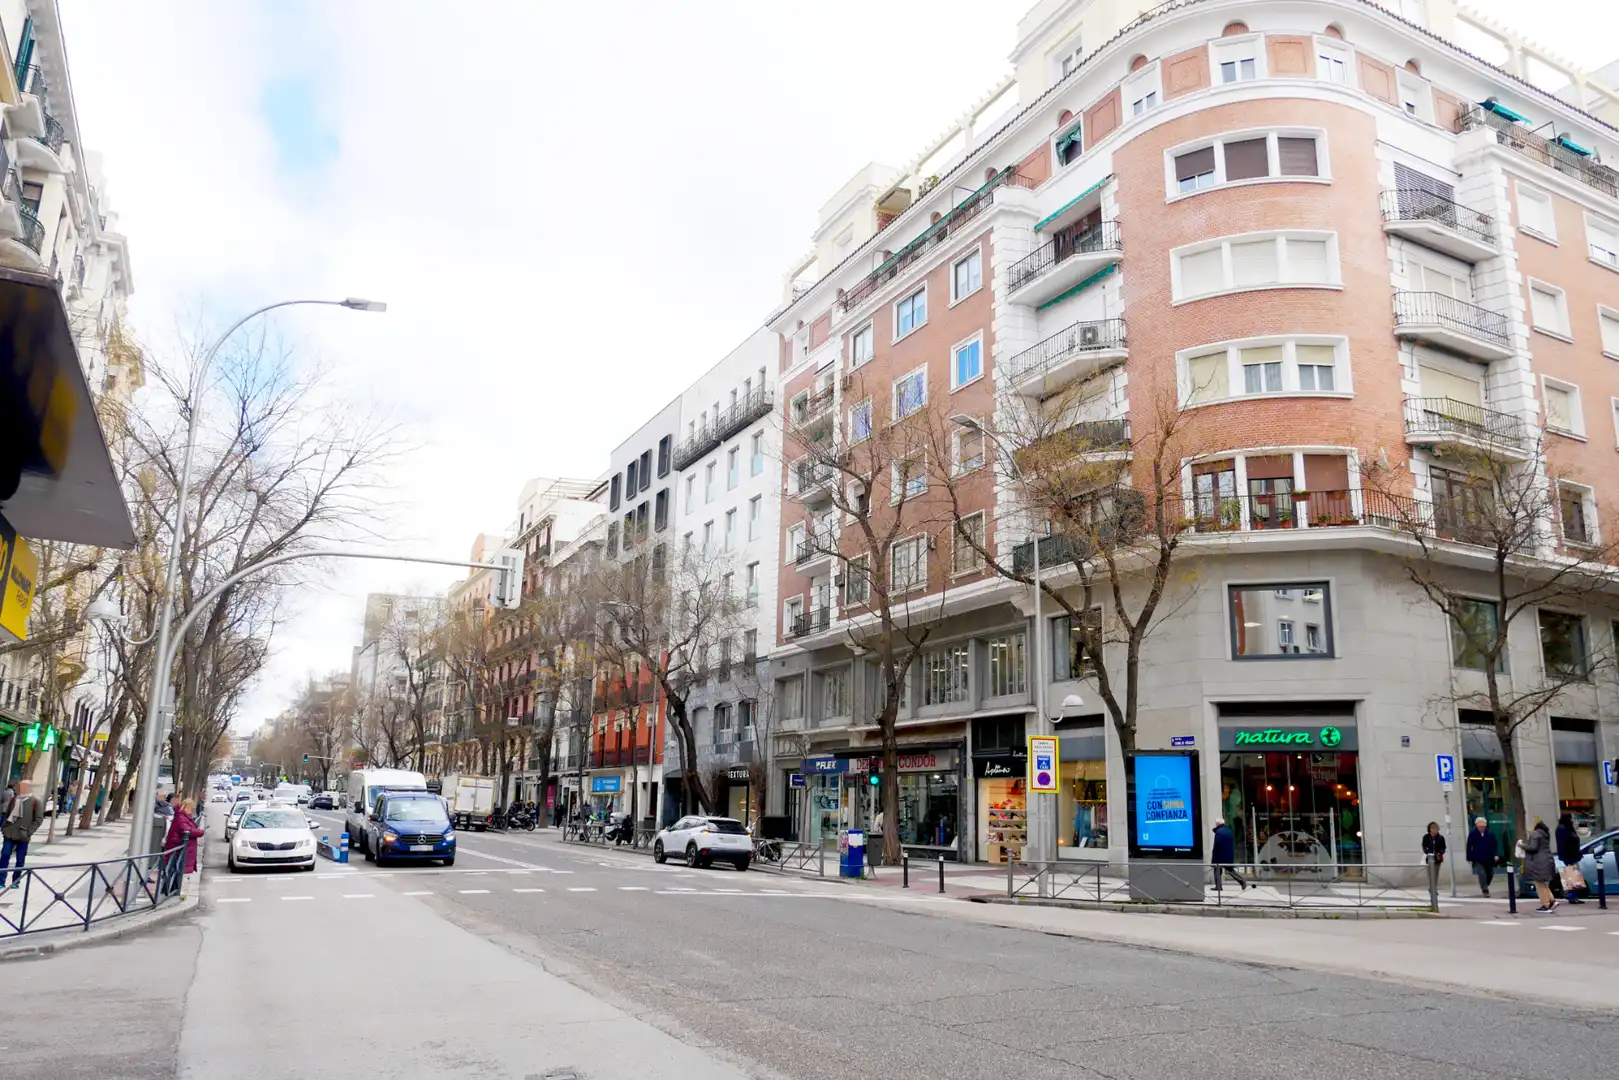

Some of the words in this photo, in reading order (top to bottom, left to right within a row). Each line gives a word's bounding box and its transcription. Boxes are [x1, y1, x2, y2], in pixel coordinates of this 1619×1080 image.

[1235, 729, 1315, 744] natura
[899, 754, 936, 769] CONDOR
[1440, 758, 1451, 779] P
[1146, 810, 1188, 820] CONFIANZA
